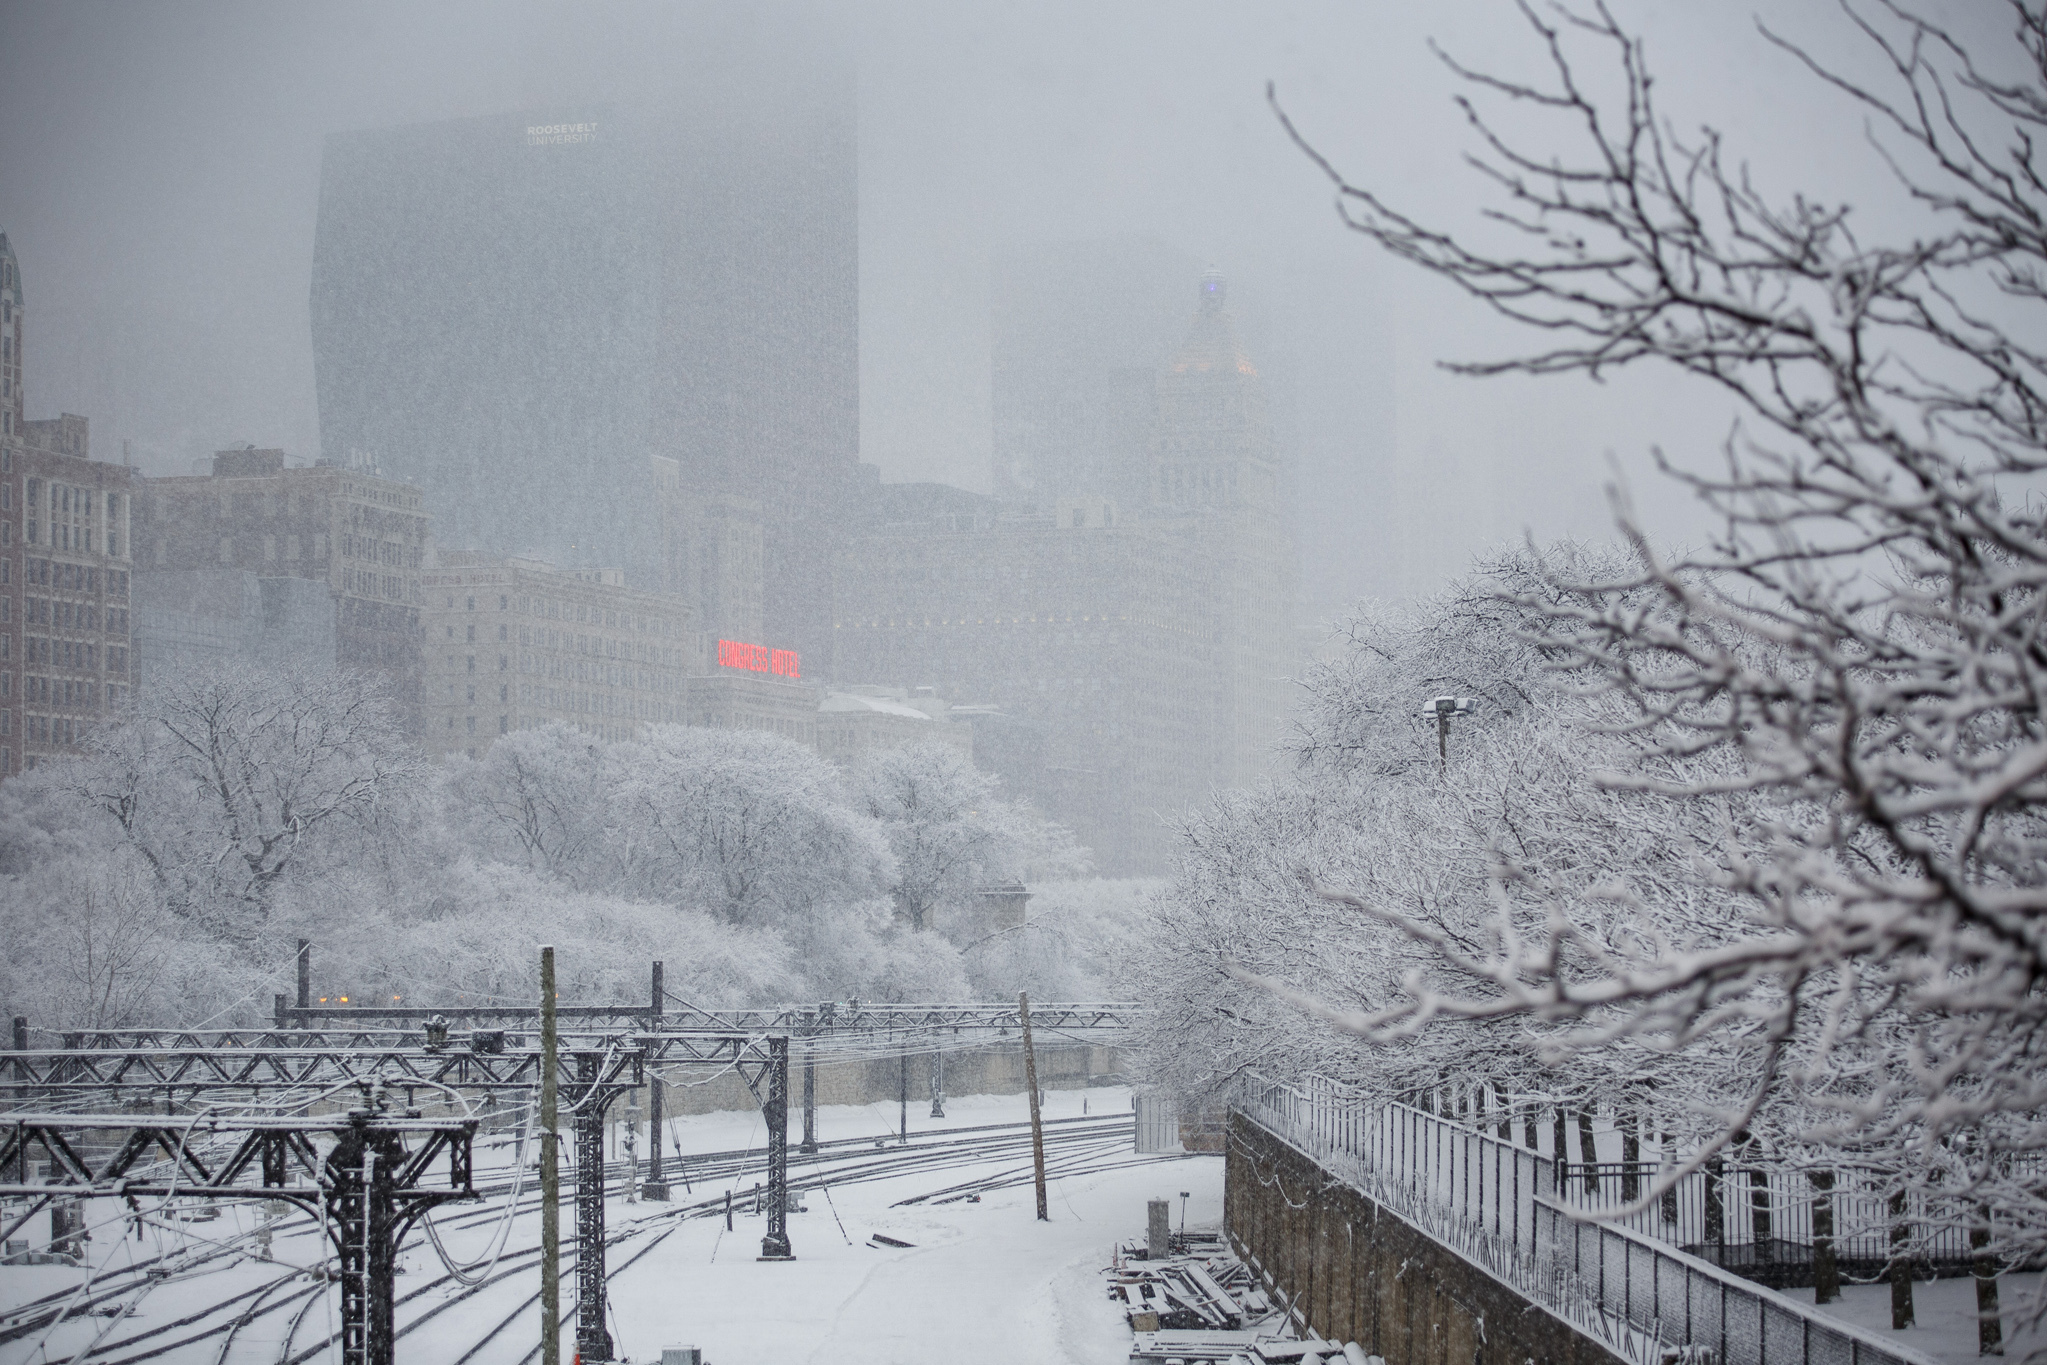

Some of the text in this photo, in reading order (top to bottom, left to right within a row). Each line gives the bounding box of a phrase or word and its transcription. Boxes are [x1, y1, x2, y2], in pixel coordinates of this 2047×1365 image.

[527, 123, 598, 135] ROOSEVELT
[527, 133, 598, 146] UNIVERSITY
[718, 639, 801, 678] CONGRESS HOTEL
